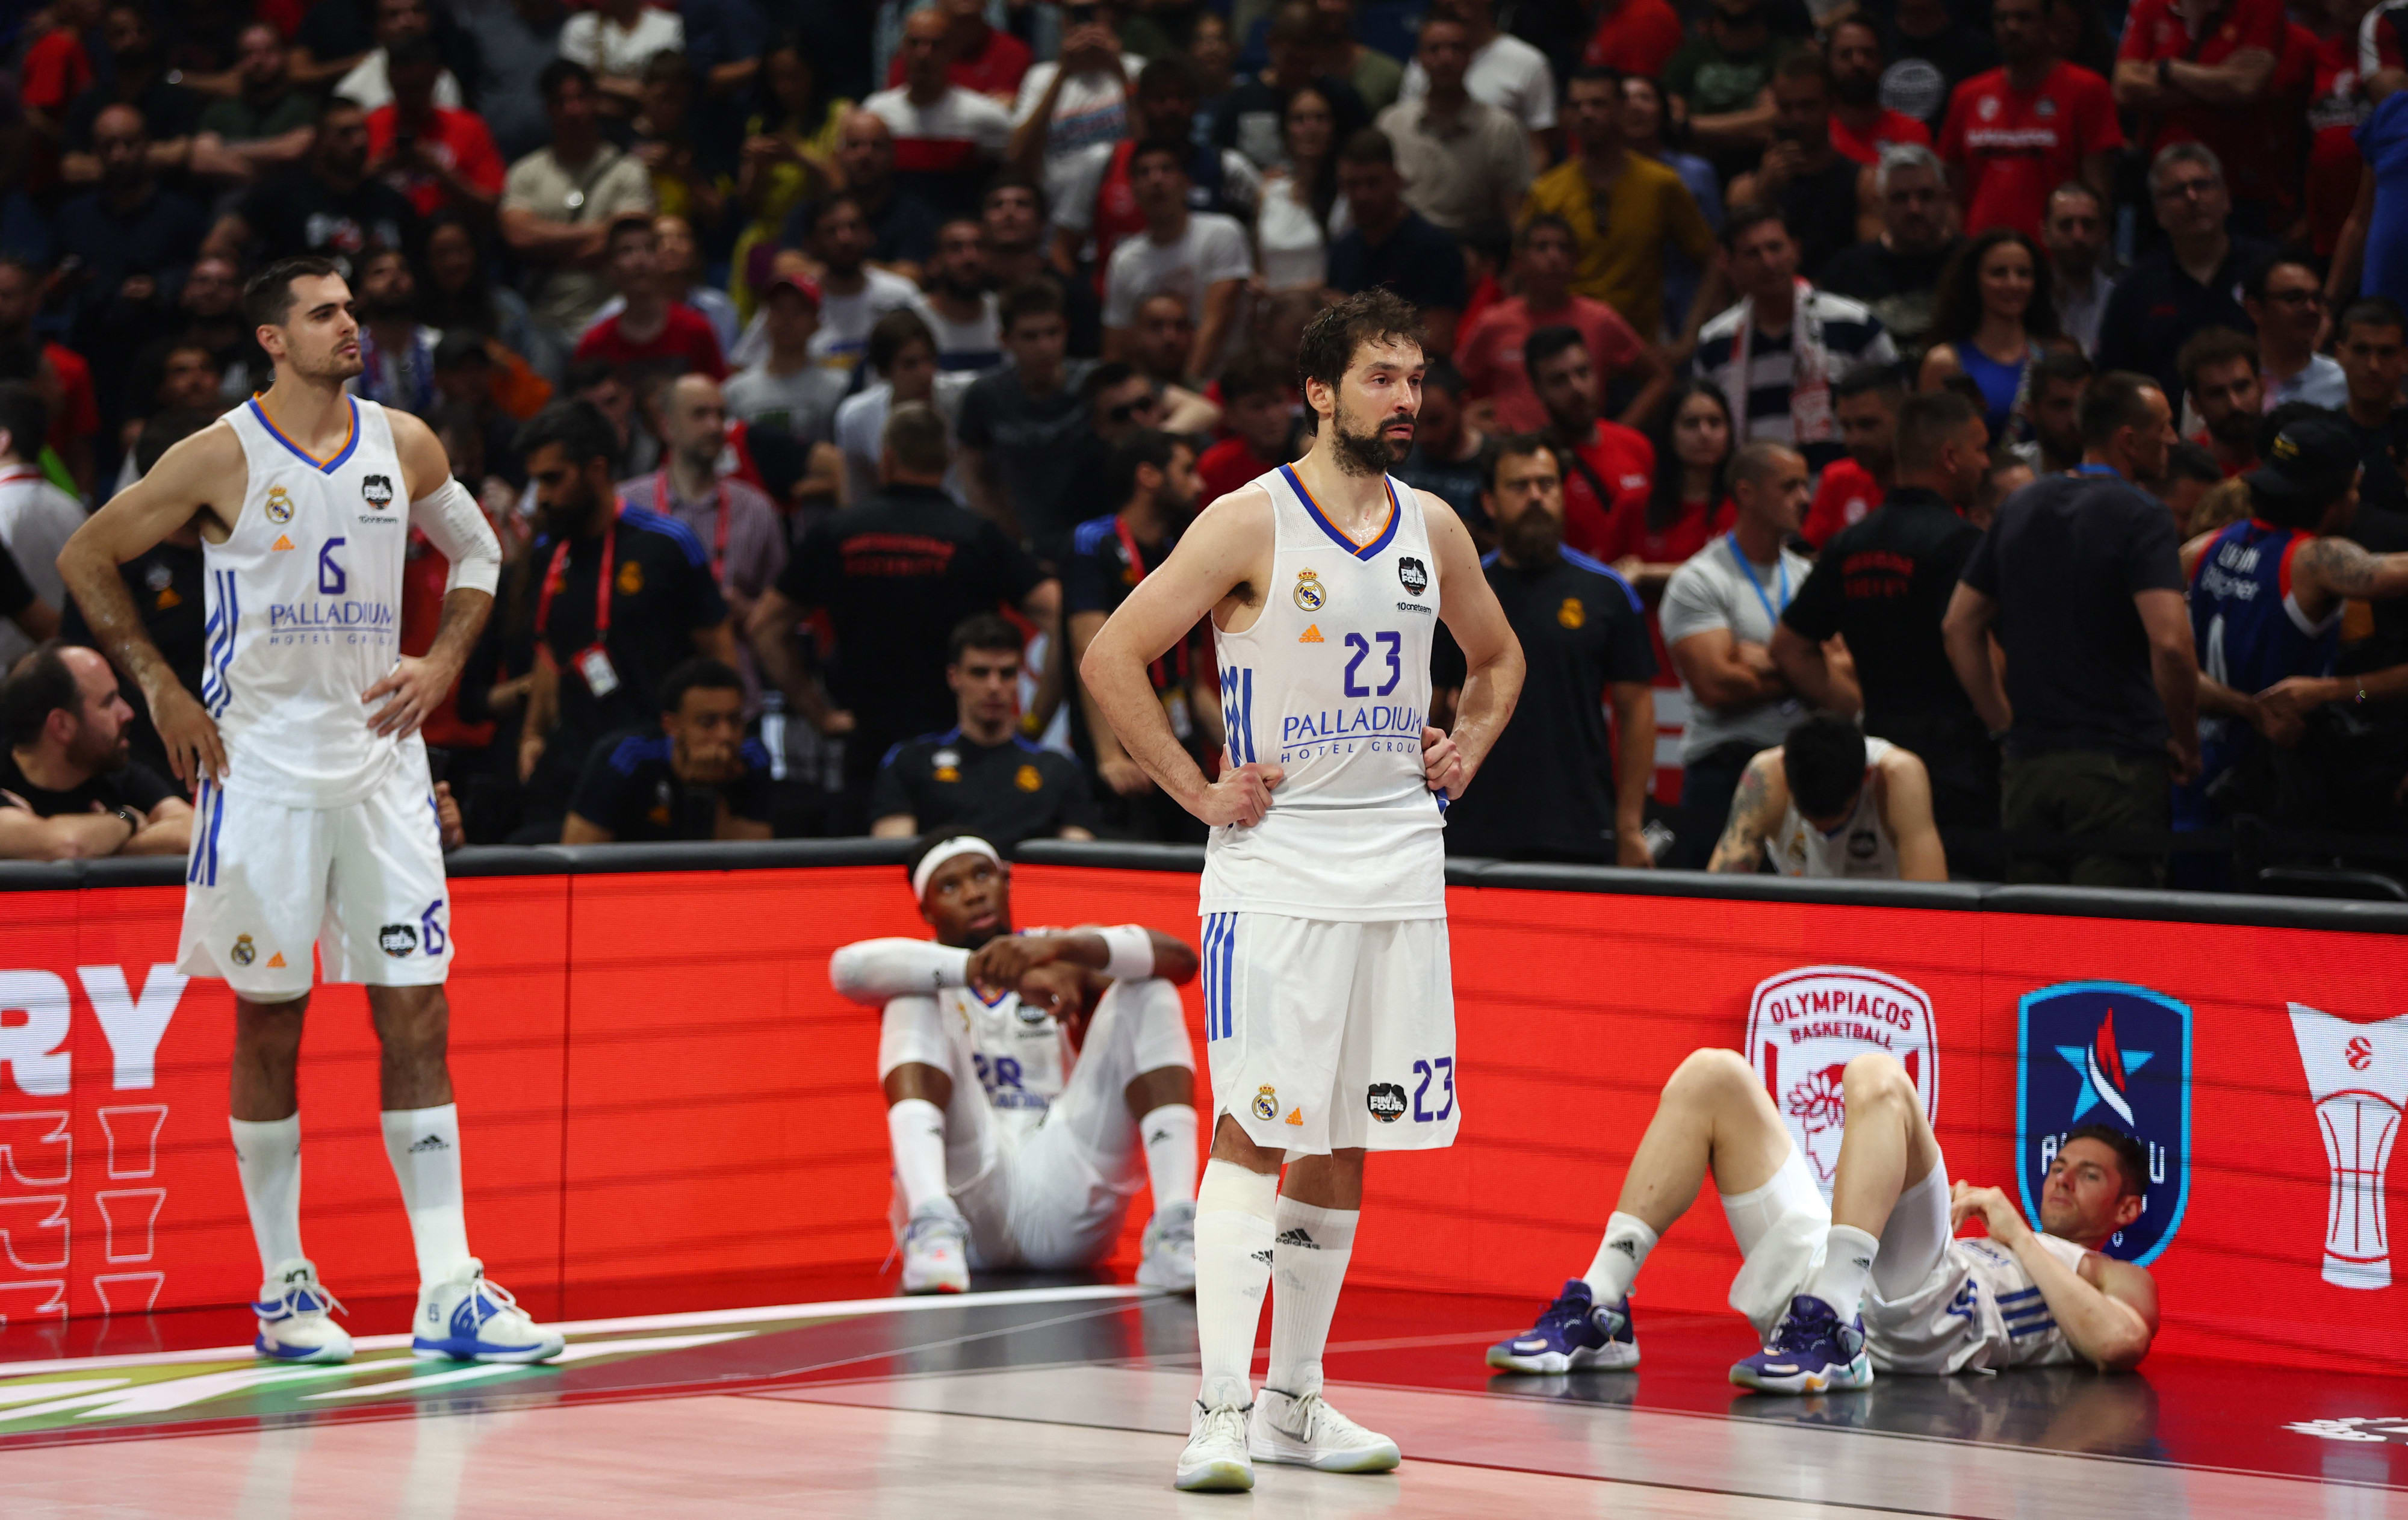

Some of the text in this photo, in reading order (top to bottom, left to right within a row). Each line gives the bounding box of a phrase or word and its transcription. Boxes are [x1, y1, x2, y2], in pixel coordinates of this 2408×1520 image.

[320, 538, 346, 594] 6
[1401, 575, 1426, 585] FOUR
[1344, 631, 1401, 698] 23
[1281, 742, 1423, 763] HOTEL GROU
[421, 899, 444, 955] 6
[1770, 990, 1913, 1030] OLYMPIACOS
[1791, 1022, 1892, 1050] BASKETBALL
[1413, 1056, 1453, 1123] 23
[1370, 1103, 1404, 1111] FOUR
[1275, 1237, 1320, 1250] adidas
